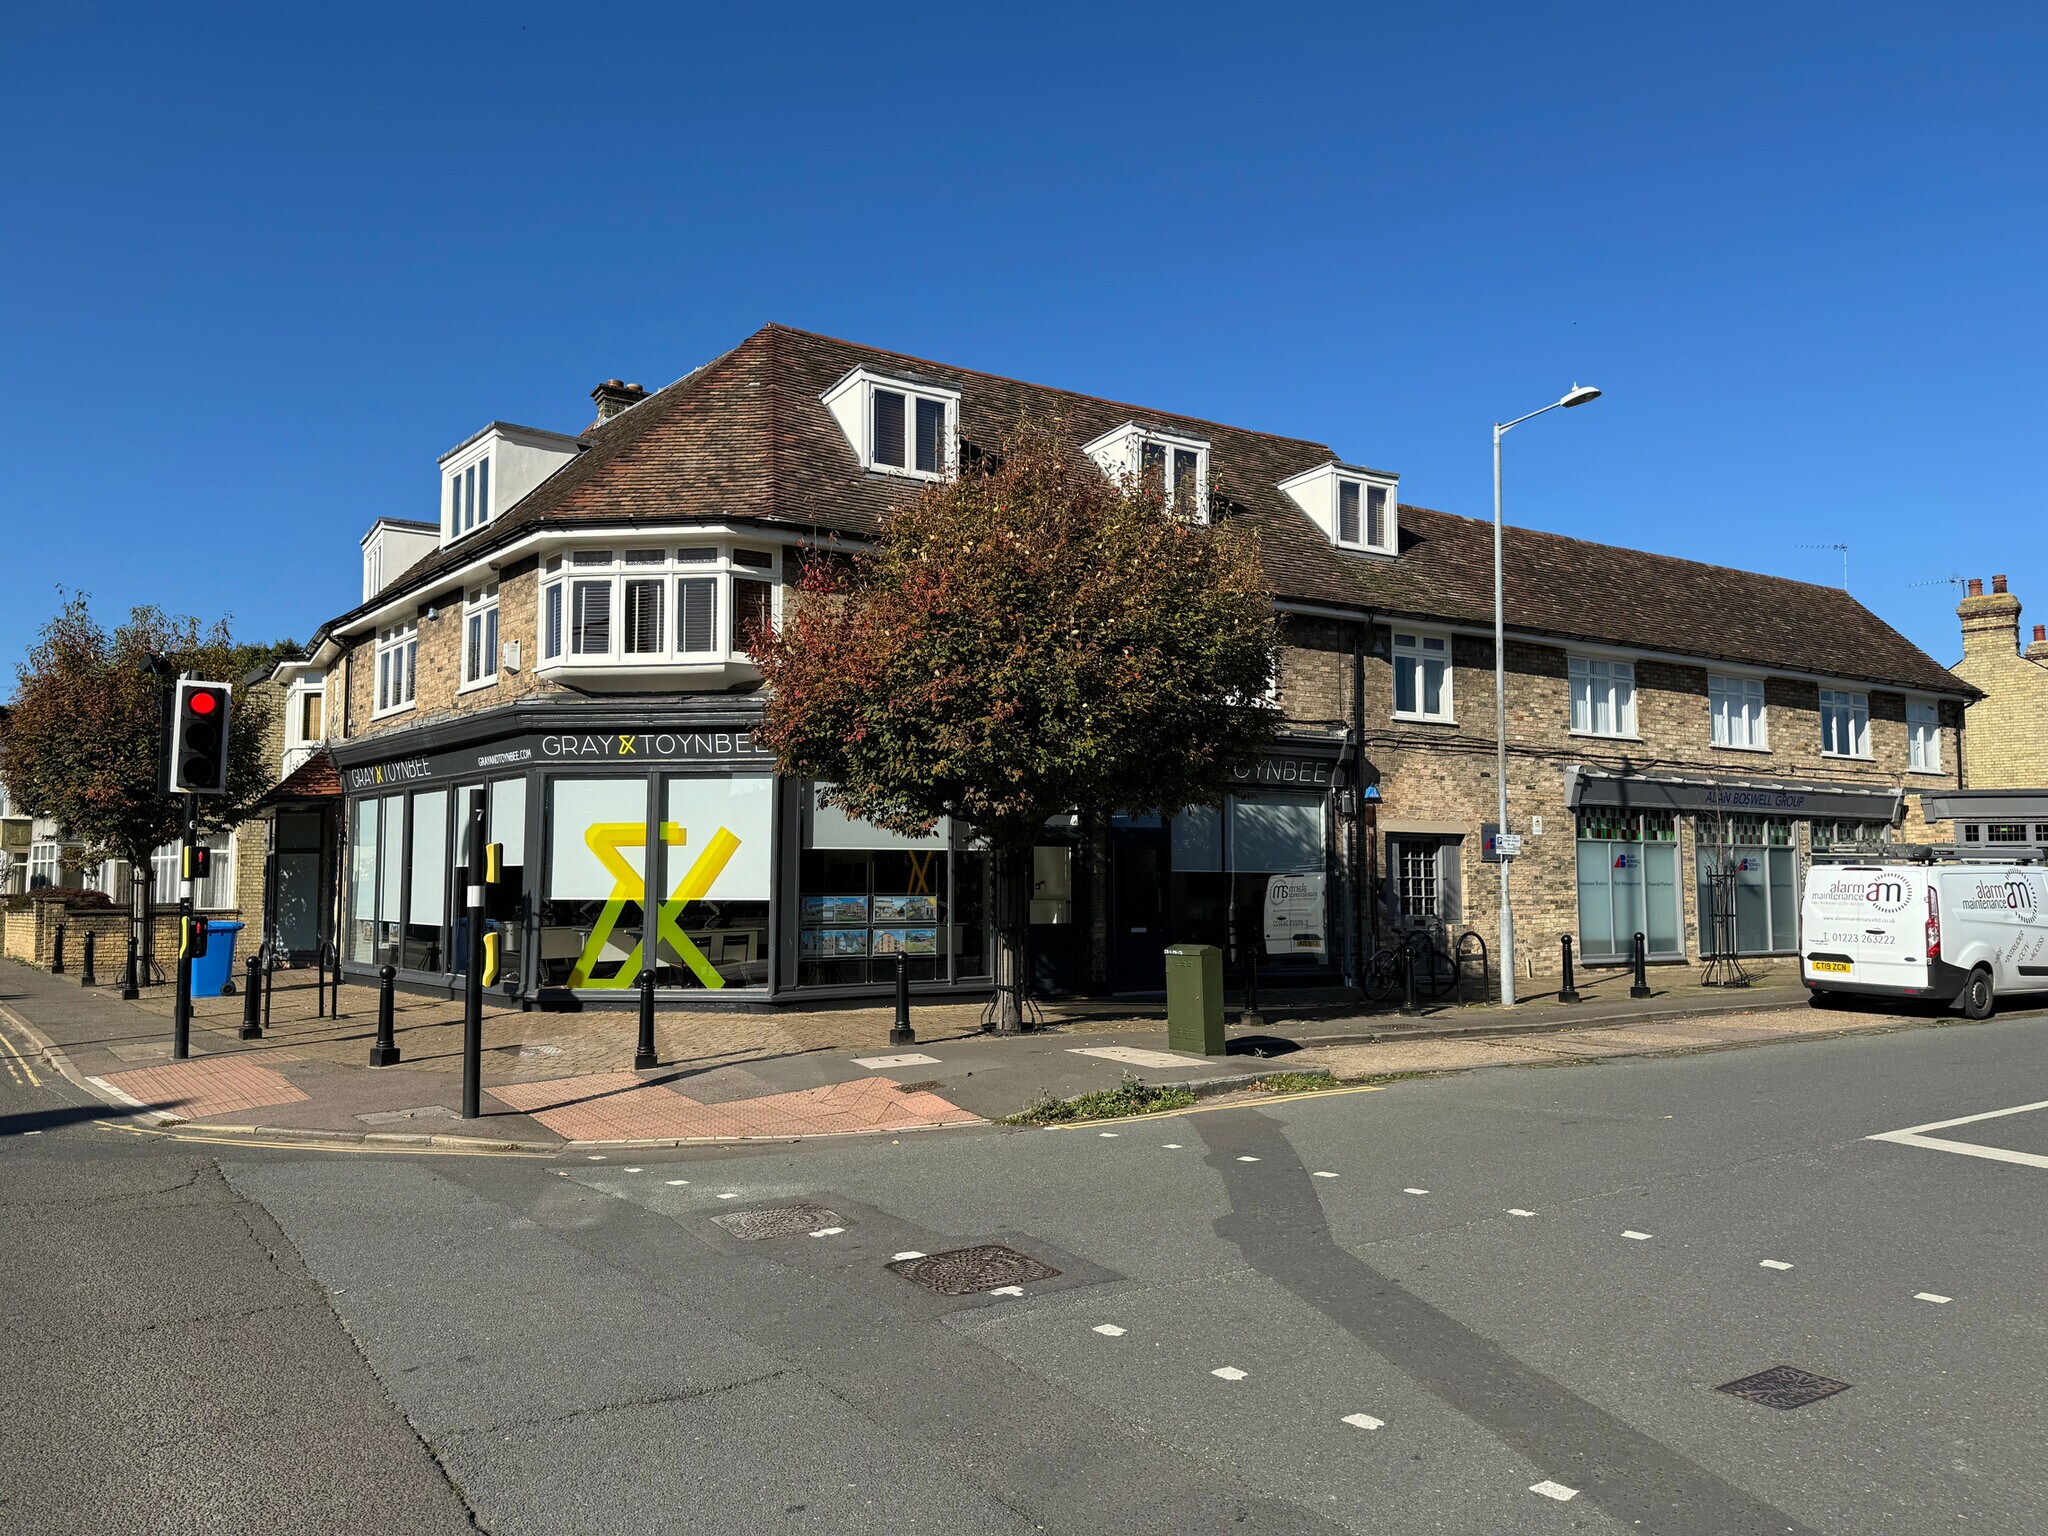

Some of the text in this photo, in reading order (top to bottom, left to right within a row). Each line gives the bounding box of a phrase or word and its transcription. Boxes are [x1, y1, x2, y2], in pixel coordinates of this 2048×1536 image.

[542, 735, 614, 756] GRAY
[382, 754, 431, 782] TOYNBEE
[1234, 759, 1328, 782] OYNBEE
[1733, 793, 1772, 806] BOSWELL
[1775, 795, 1805, 807] GROUP
[475, 809, 485, 821] 7
[189, 820, 197, 830] 6
[1830, 880, 1864, 893] alarm
[1866, 883, 1901, 902] am
[1976, 880, 2005, 898] alarm
[1812, 892, 1864, 901] maintenance
[2004, 882, 2032, 909] am
[1962, 897, 2007, 909] maintenance
[1832, 933, 1858, 943] 01223
[1861, 935, 1895, 945] 263222
[1816, 962, 1831, 970] CT19
